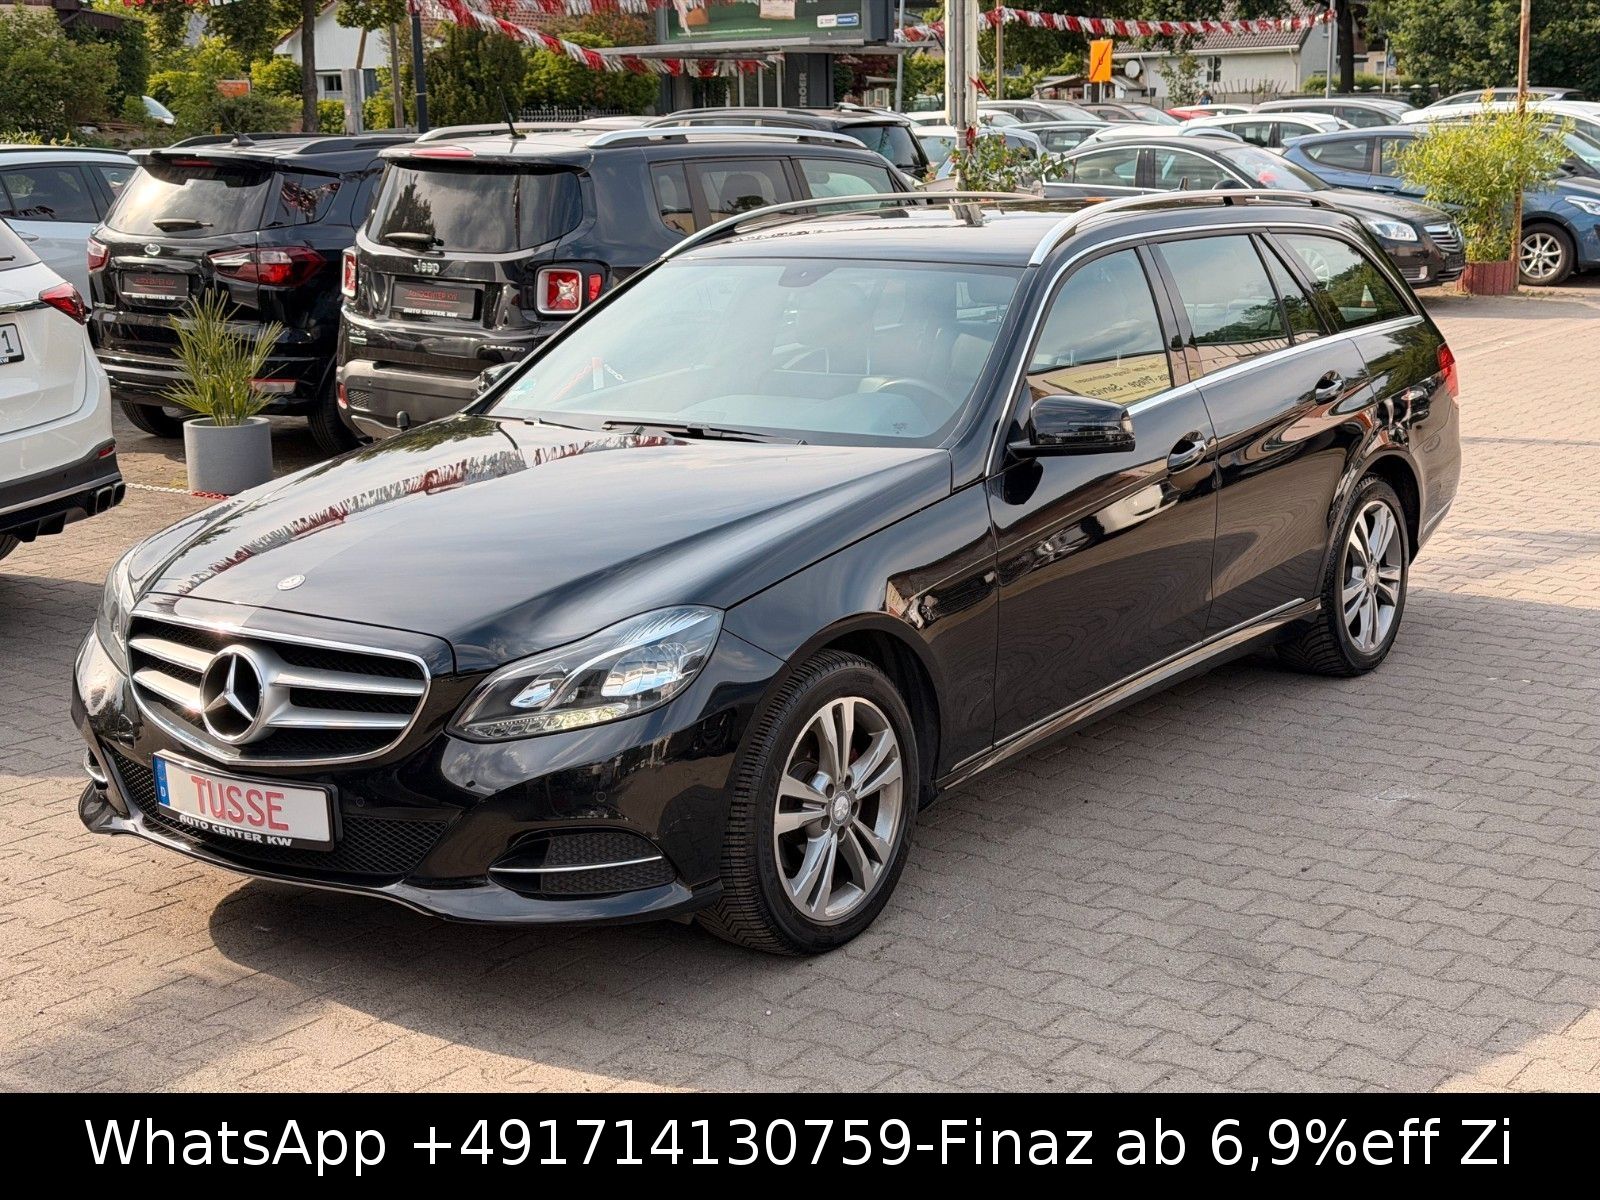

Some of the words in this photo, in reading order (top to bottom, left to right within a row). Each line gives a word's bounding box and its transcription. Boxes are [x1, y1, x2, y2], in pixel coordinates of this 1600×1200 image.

[413, 259, 440, 277] Jeep
[403, 307, 421, 315] AUTO
[422, 308, 446, 317] CENTER
[190, 775, 289, 831] TUSSE
[179, 814, 209, 830] AUTO
[212, 823, 263, 844] CENTER
[267, 835, 293, 847] KW
